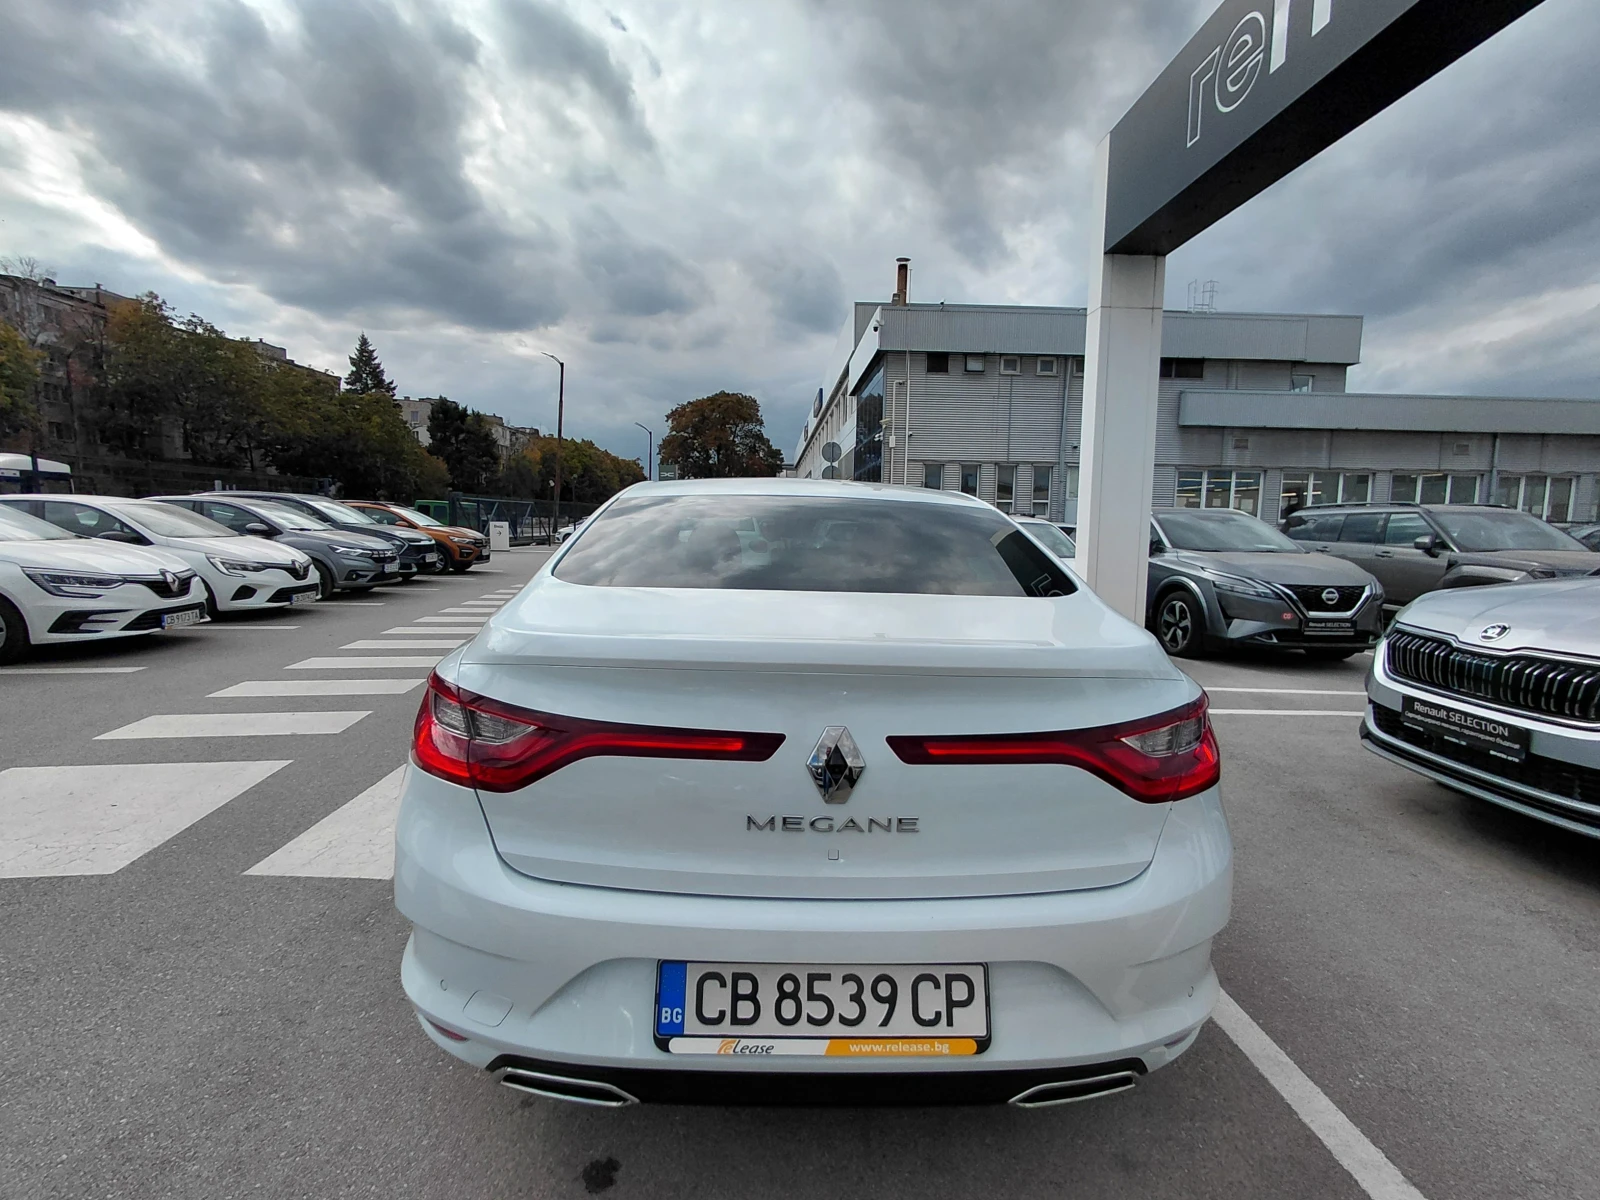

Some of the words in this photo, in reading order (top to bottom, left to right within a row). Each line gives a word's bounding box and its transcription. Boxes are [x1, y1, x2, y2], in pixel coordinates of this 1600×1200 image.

[1414, 701, 1447, 720] Renault
[1449, 711, 1508, 737] SELECTION
[746, 814, 920, 833] MEGANE
[695, 971, 761, 1026] CB
[774, 972, 898, 1027] 8539
[911, 973, 975, 1027] CP
[661, 1007, 682, 1023] BG
[849, 1041, 950, 1054] www.release.bg
